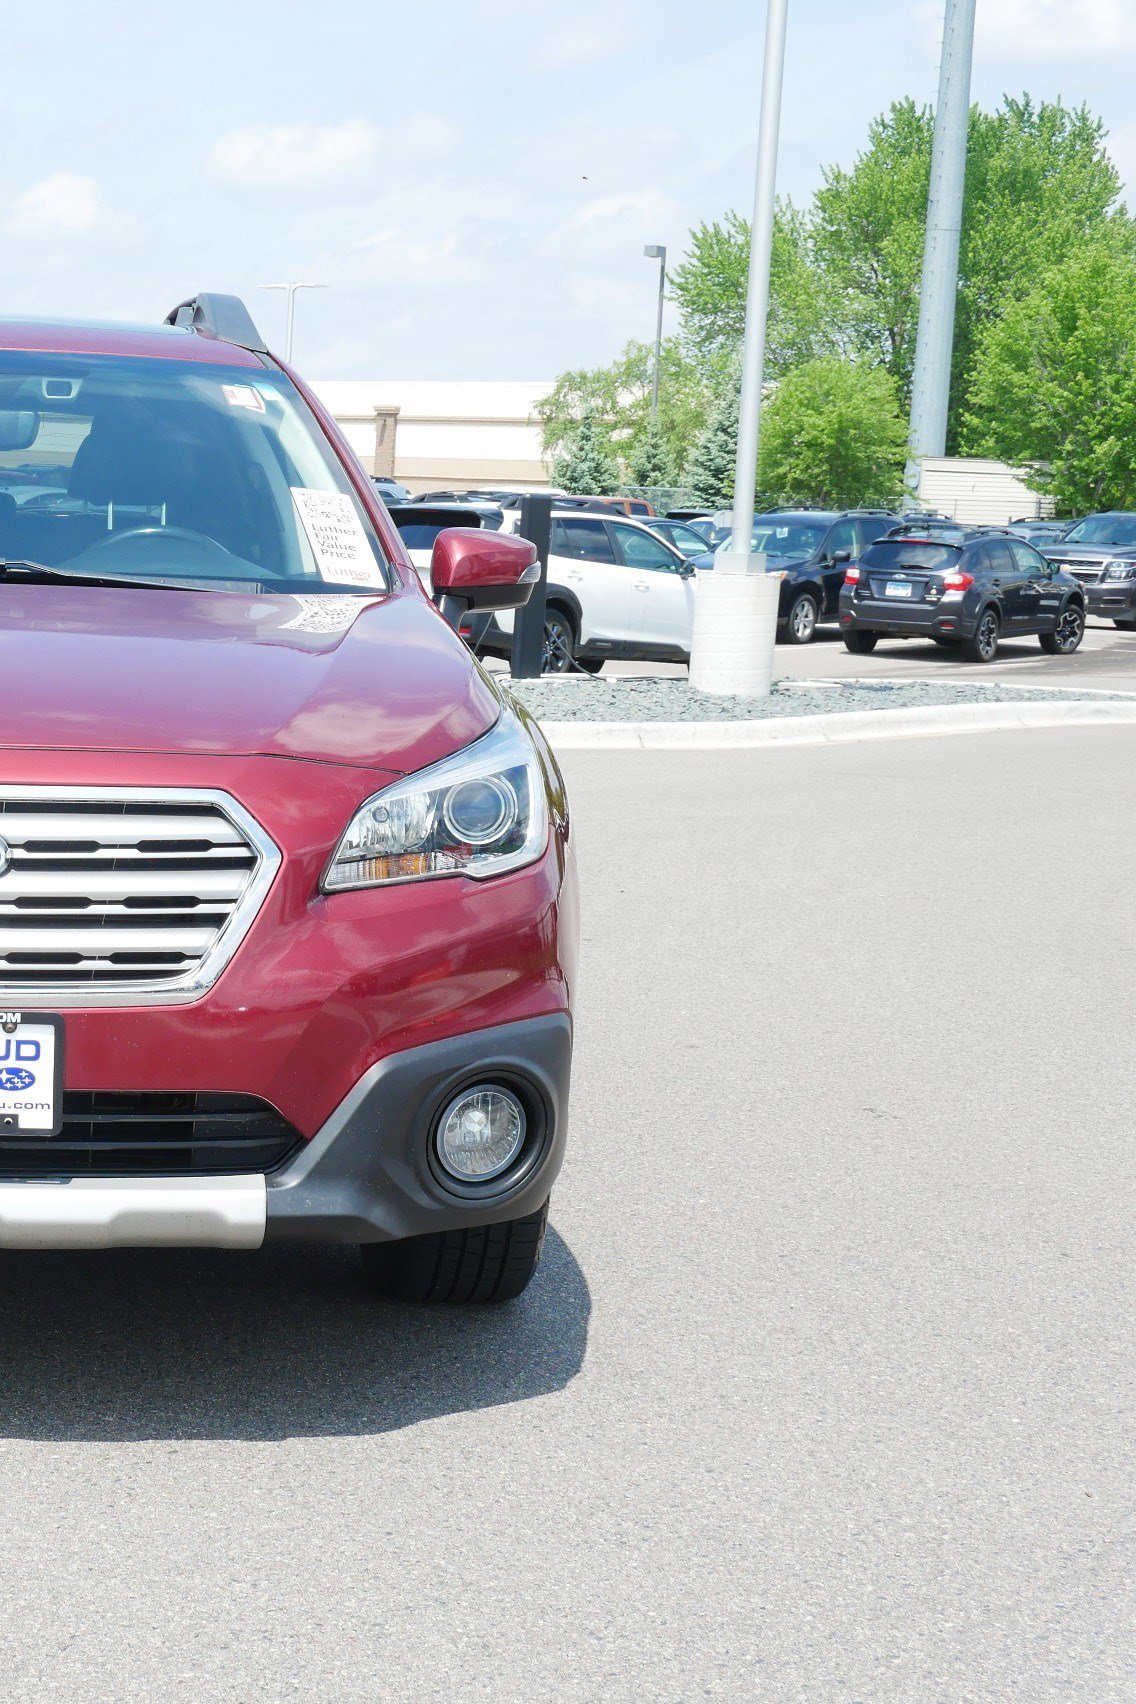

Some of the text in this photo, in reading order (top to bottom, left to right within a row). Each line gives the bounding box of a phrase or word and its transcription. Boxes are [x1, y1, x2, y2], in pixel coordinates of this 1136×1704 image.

[312, 524, 356, 535] Luther
[315, 532, 339, 541] Fair
[318, 540, 356, 552] Value
[321, 548, 356, 559] Price
[327, 566, 371, 579] Luther
